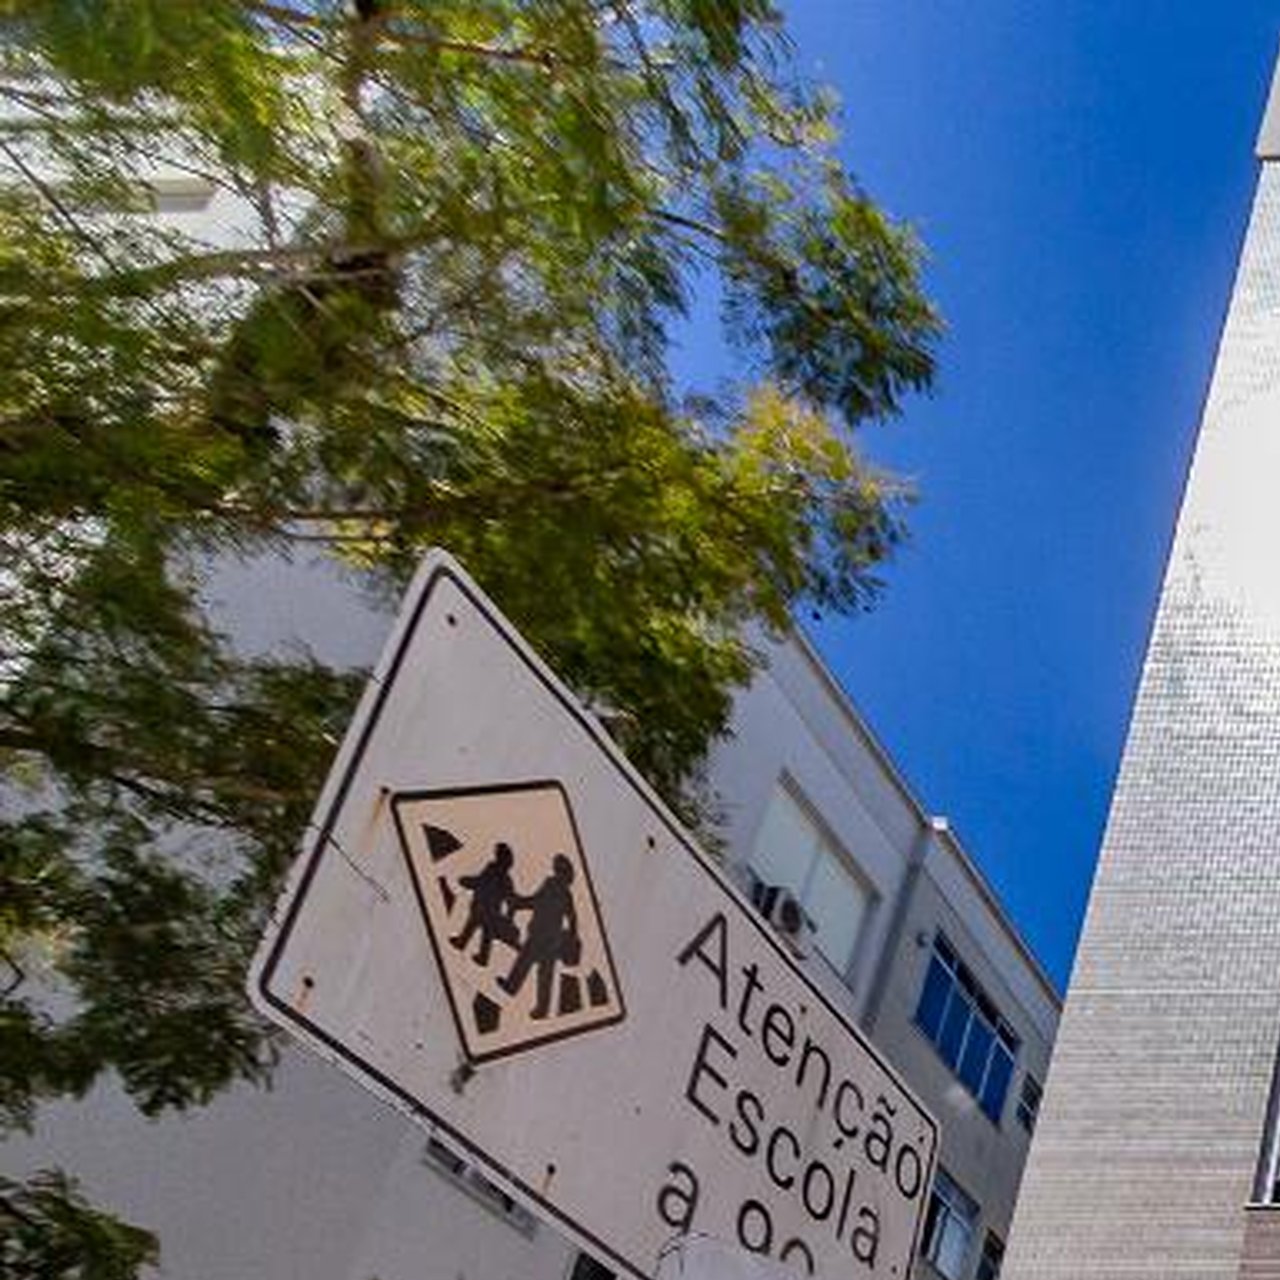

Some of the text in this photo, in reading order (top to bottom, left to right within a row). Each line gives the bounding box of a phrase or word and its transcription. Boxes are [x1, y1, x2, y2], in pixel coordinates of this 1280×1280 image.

[676, 911, 922, 1200] Atenção
[685, 1022, 880, 1270] Escola
[658, 1160, 698, 1234] a
